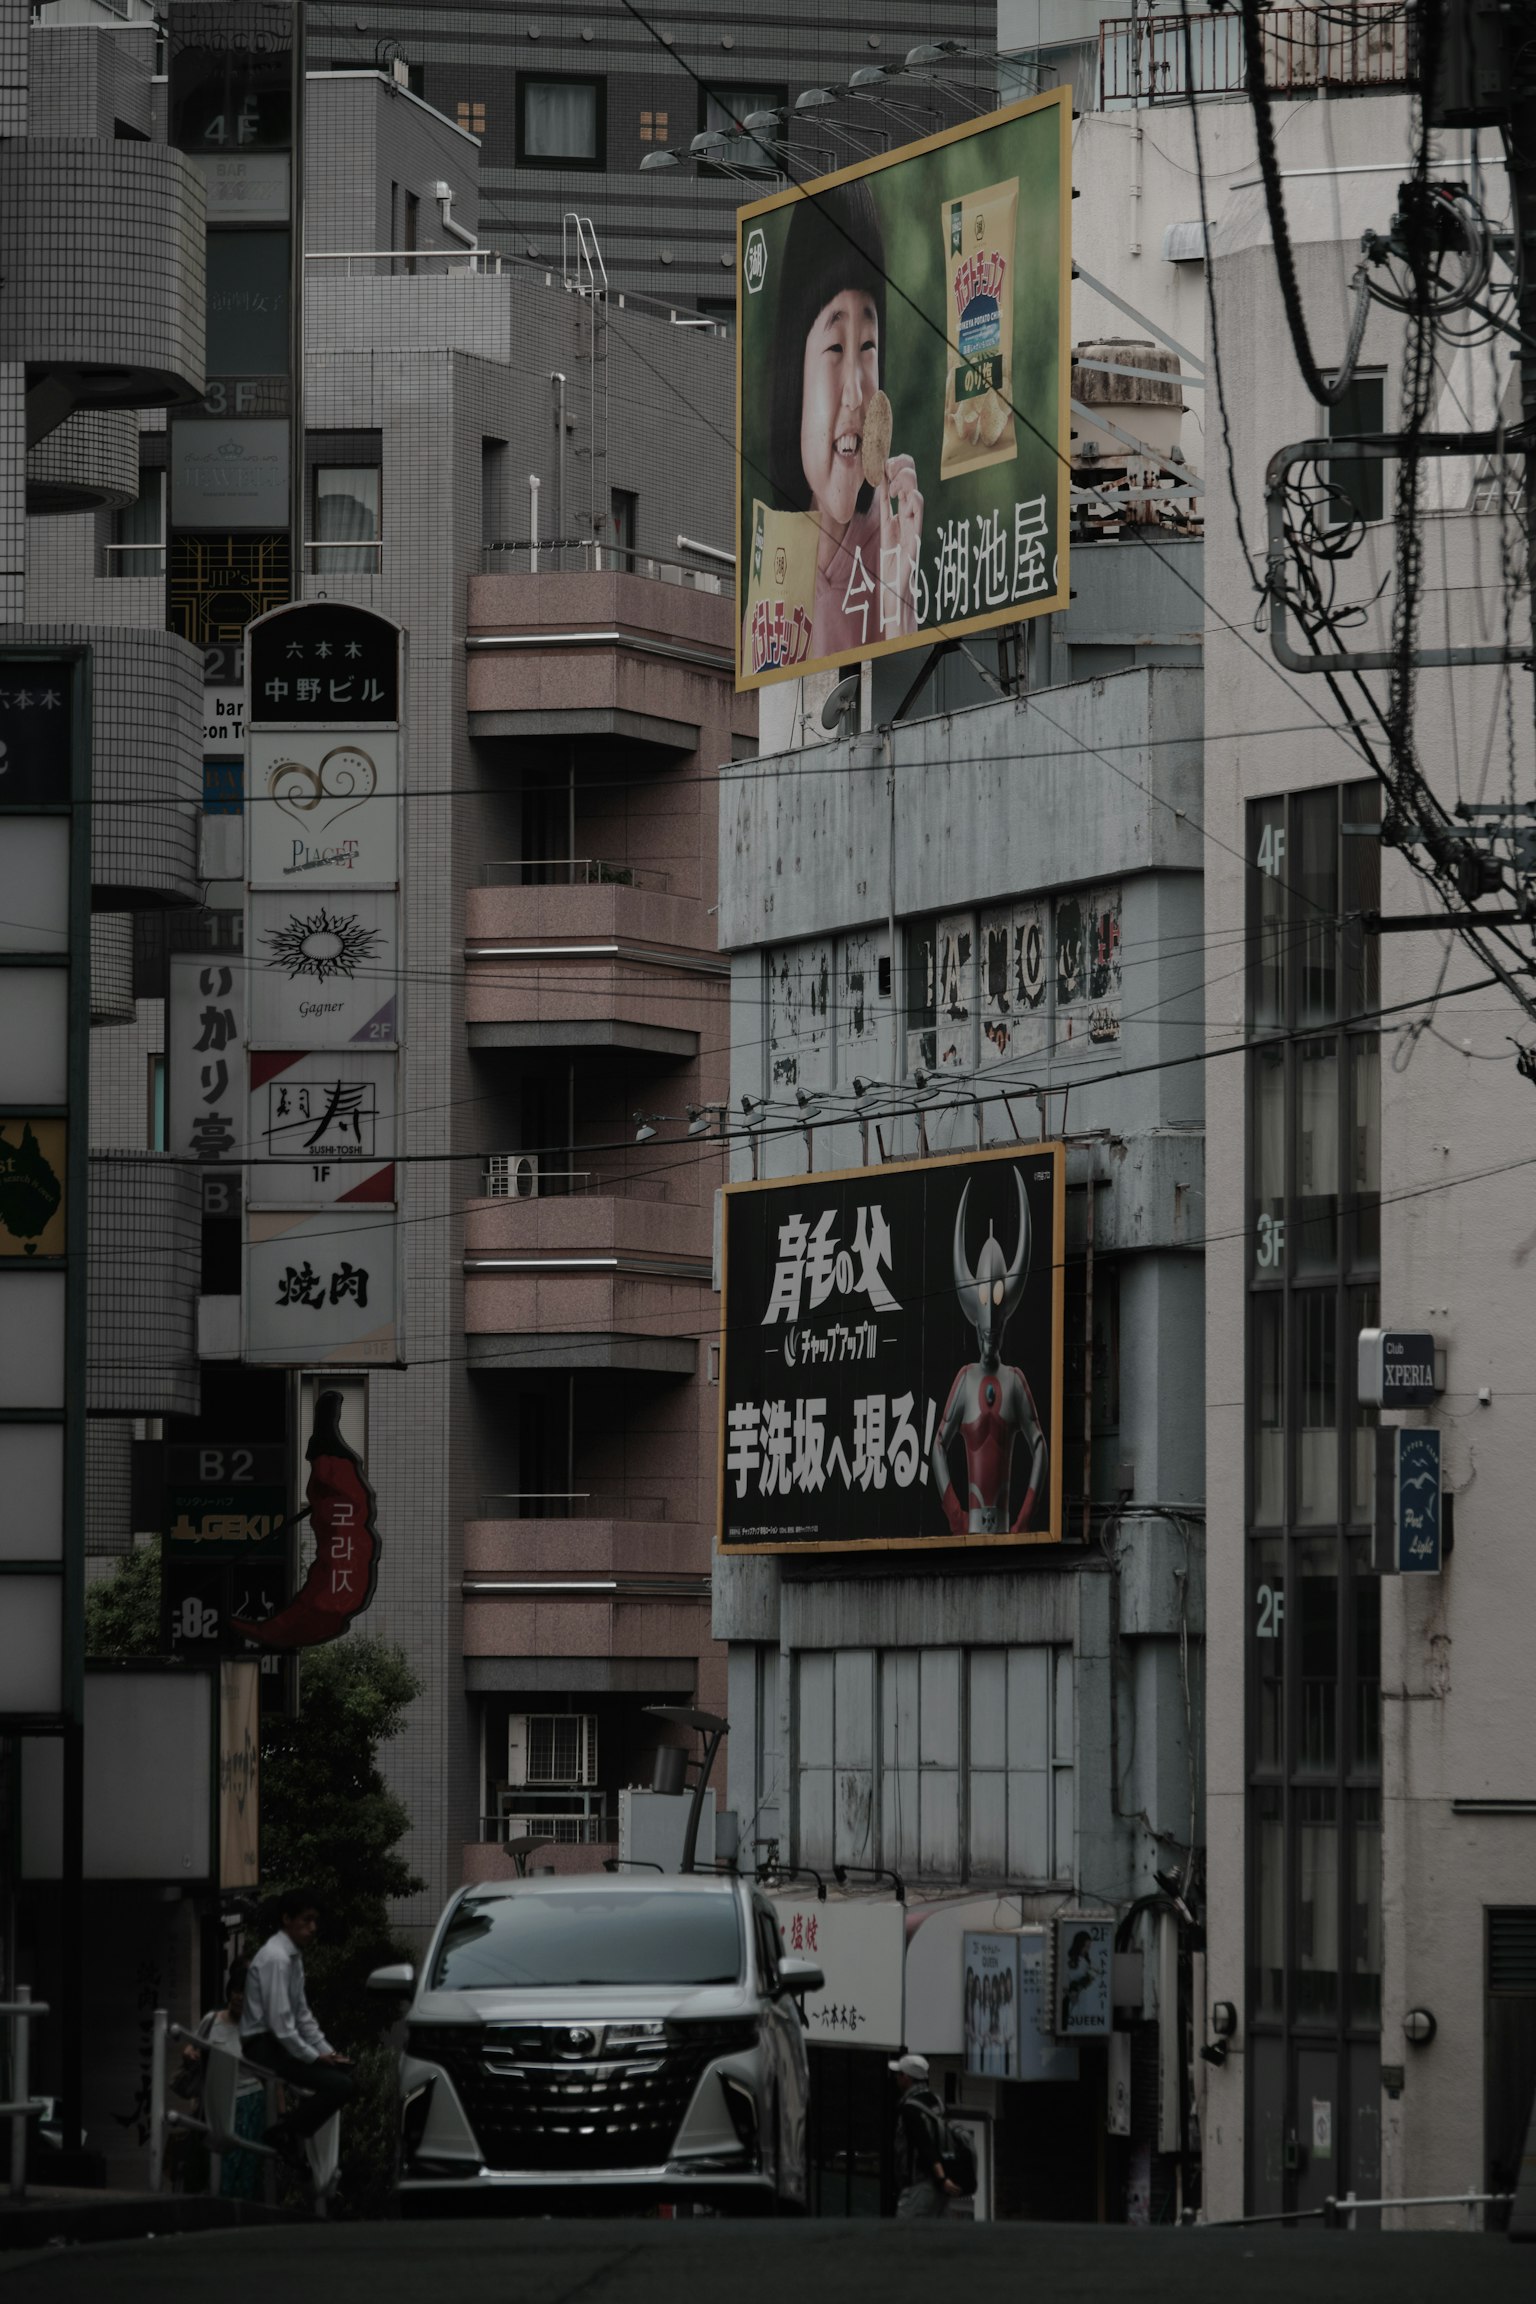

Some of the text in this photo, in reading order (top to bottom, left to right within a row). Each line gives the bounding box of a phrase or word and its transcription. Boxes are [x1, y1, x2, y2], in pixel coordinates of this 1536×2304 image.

[205, 115, 260, 144] 4F
[954, 250, 1006, 316] ポテトチップス
[964, 361, 993, 393] のり塩
[204, 381, 258, 413] 3F
[209, 569, 250, 588] JIP's
[286, 641, 363, 659] 六本木
[264, 674, 385, 702] 中野ビル
[216, 698, 243, 716] bar
[1257, 824, 1284, 876] 4F
[299, 1001, 344, 1018] Gagner
[369, 1022, 391, 1039] 2F
[188, 966, 239, 1159] いかり亭
[313, 1166, 330, 1182] 1F
[1256, 1213, 1285, 1267] 3F
[760, 1203, 903, 1326] 育毛の父
[275, 1260, 370, 1310] 焼肉
[1386, 1342, 1405, 1355] Club
[1385, 1364, 1433, 1386] XPERIA
[200, 1450, 254, 1481] B2
[1256, 1584, 1284, 1638] 2F
[1066, 2015, 1106, 2026] QUEEN
